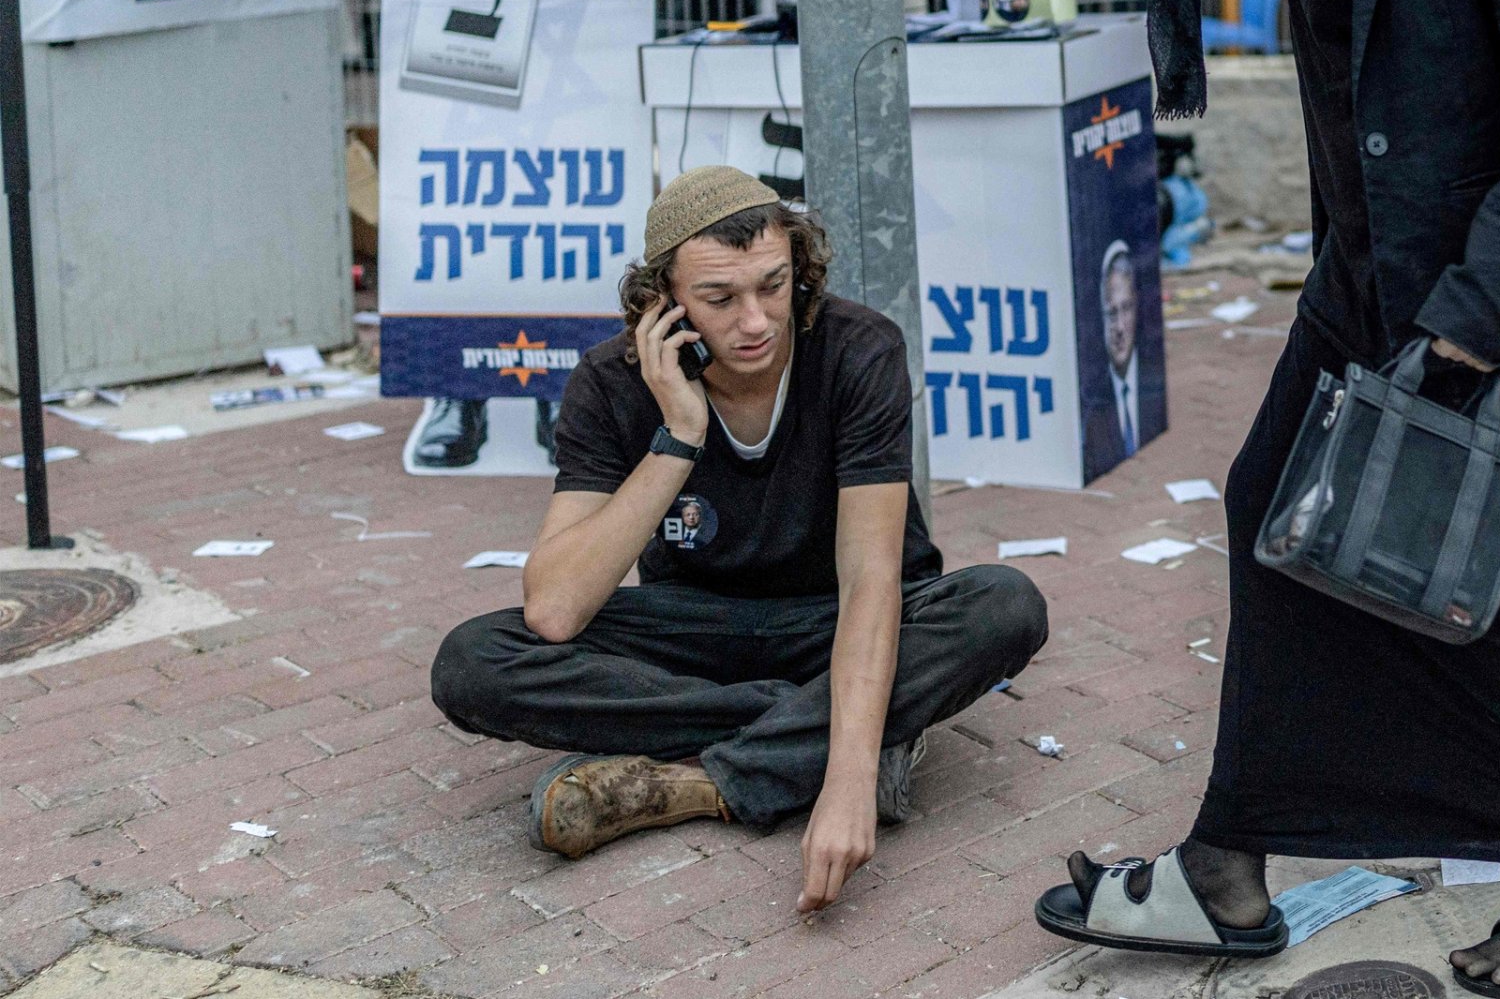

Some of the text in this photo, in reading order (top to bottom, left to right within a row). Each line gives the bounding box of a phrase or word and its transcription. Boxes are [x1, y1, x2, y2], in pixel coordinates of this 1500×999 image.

[418, 147, 625, 207] עוצמה
[414, 222, 625, 282] יהודית
[928, 285, 1049, 357] עוצ
[925, 372, 1054, 442] יהוד
